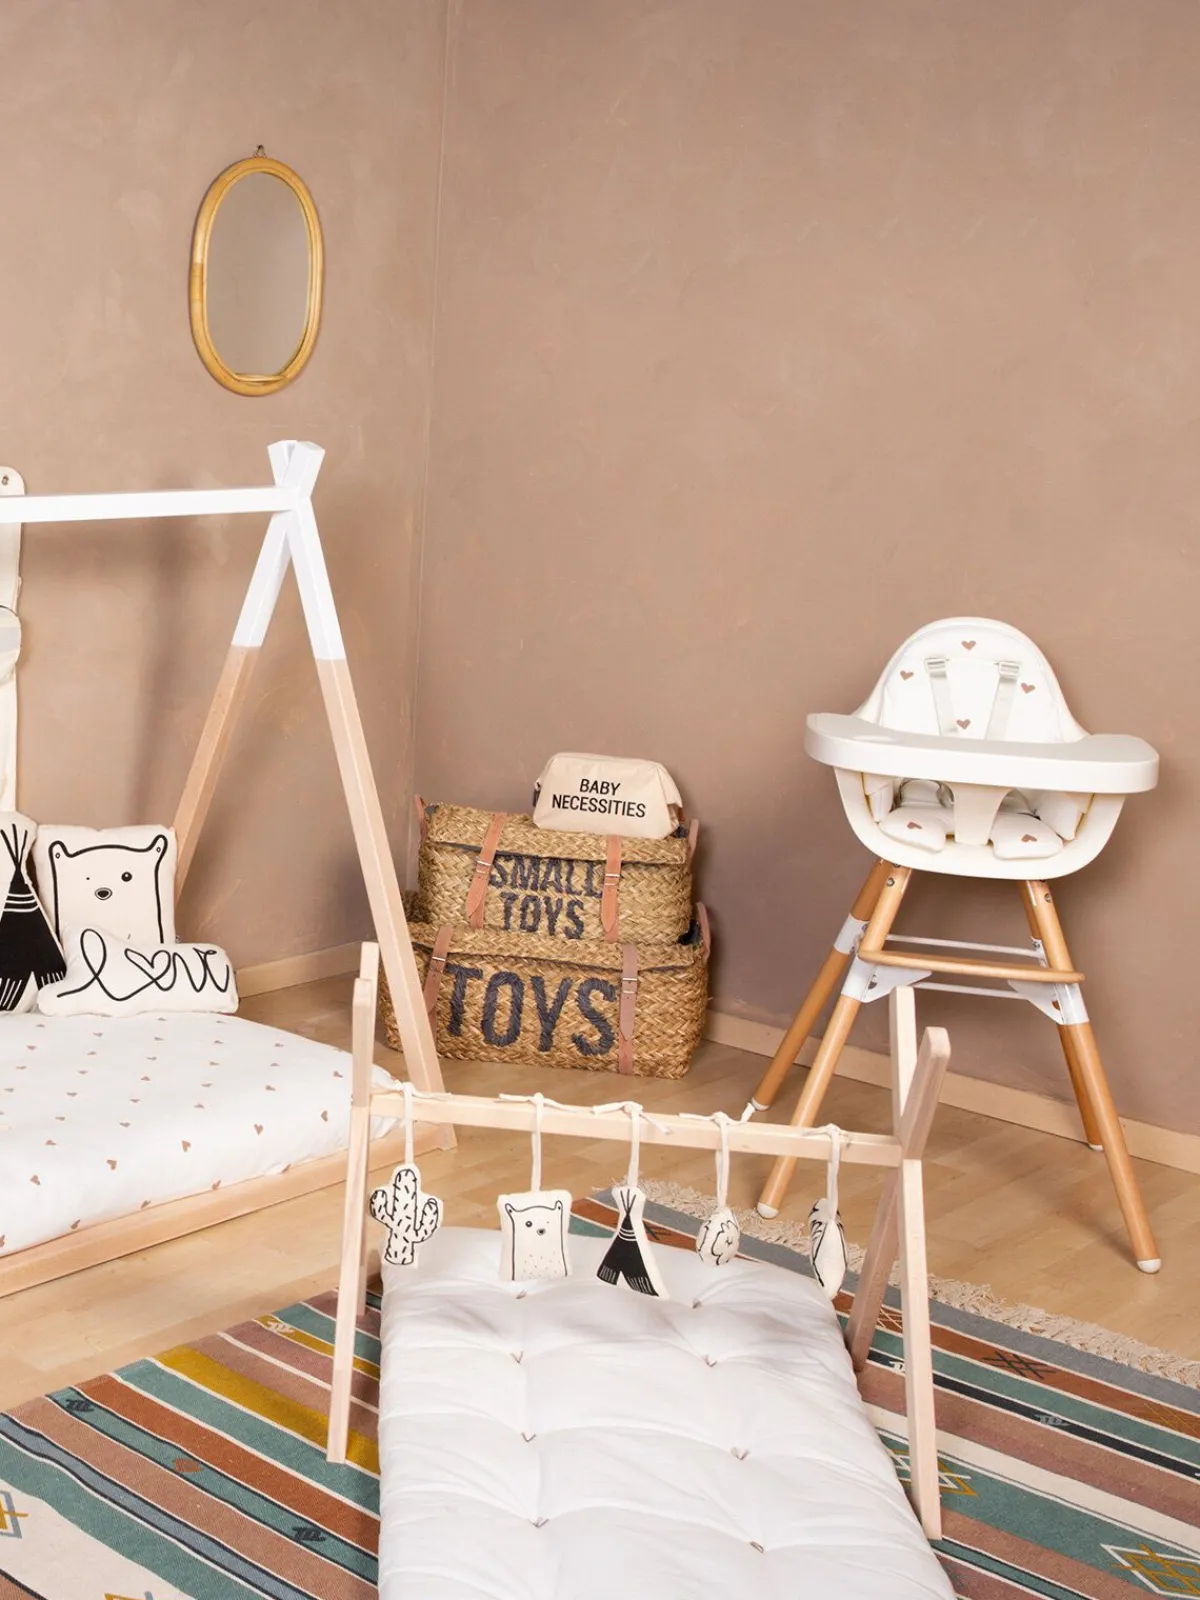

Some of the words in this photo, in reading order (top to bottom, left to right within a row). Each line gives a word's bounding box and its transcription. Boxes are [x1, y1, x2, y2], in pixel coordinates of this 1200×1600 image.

[551, 793, 646, 818] NECESSITIES
[579, 778, 621, 796] BABY
[488, 855, 603, 898] SMALL
[500, 891, 585, 940] TOYS
[446, 964, 619, 1057] TOYS
